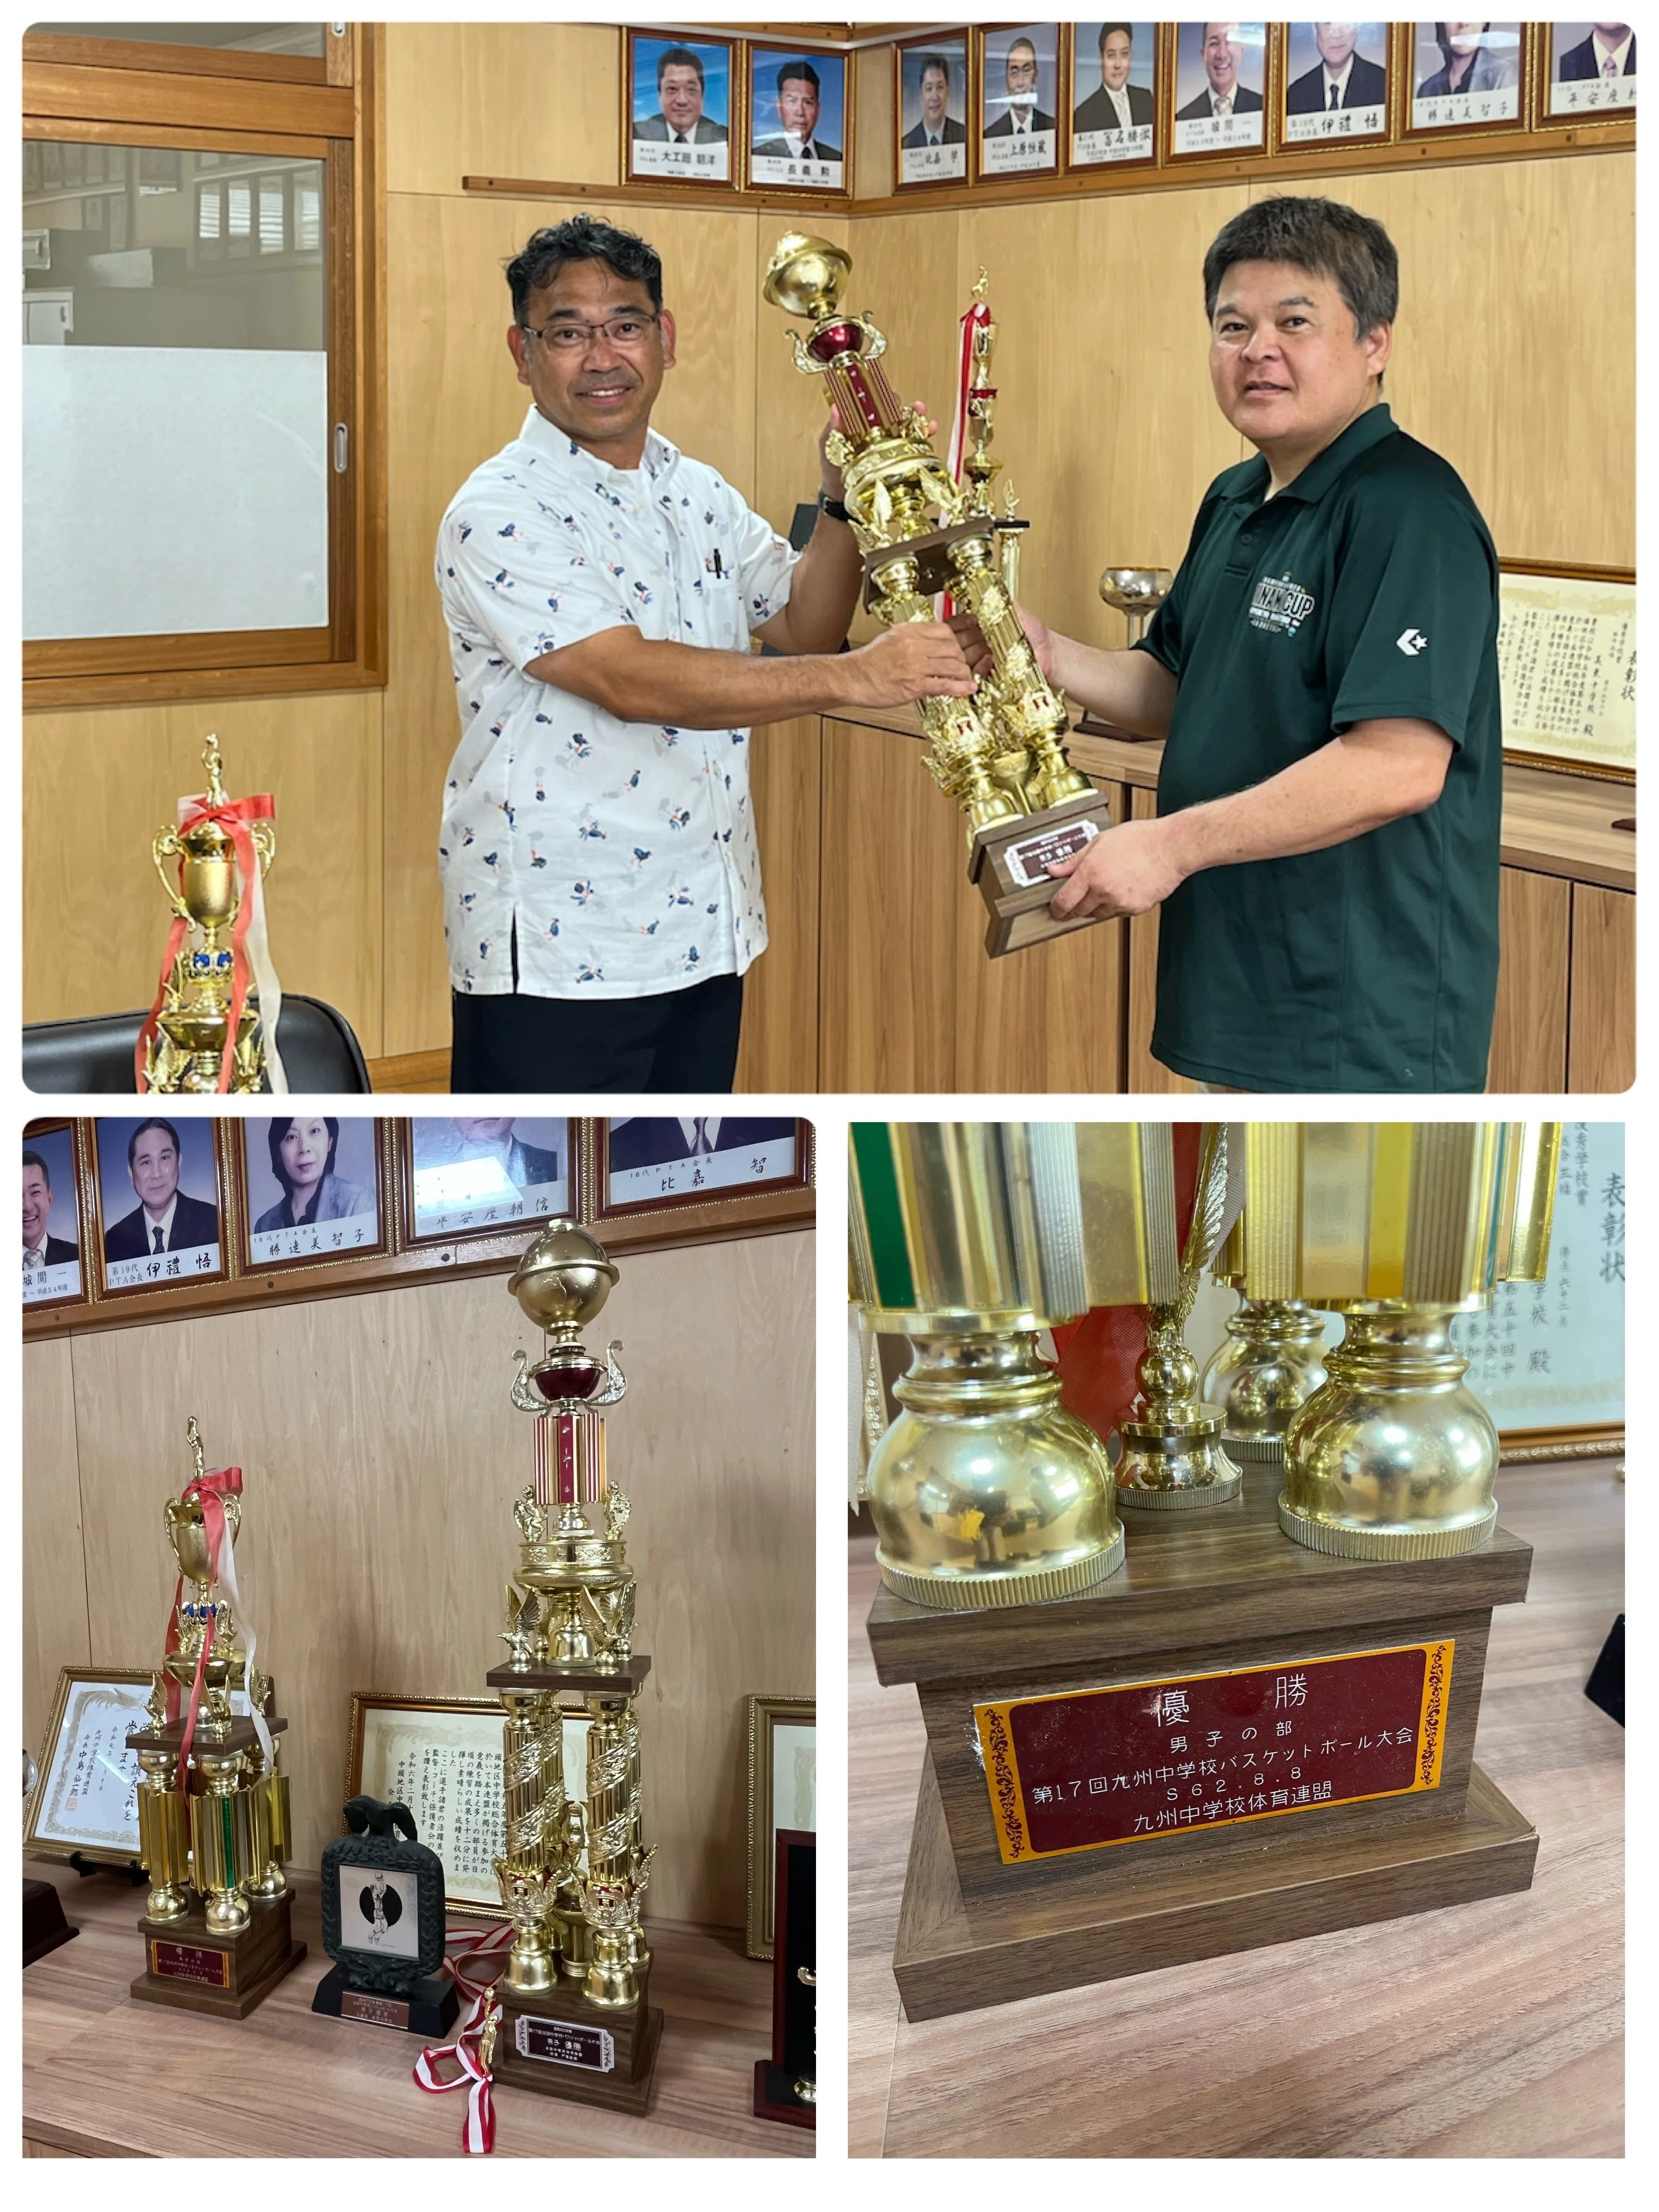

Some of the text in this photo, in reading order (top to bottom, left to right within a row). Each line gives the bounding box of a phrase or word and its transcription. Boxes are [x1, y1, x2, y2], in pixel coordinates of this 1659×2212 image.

[269, 1229, 364, 1256] 勝連美智子
[109, 1272, 144, 1286] PTA会長
[112, 1264, 138, 1276] 第19代
[1156, 1675, 1309, 1728] 優勝
[1170, 1721, 1293, 1753] 男子の部
[449, 1750, 457, 1766] した
[1032, 1727, 1414, 1805] 第17回九州中学校バスケットボール大会
[1134, 1780, 1333, 1832] 九州中学校体育連盟
